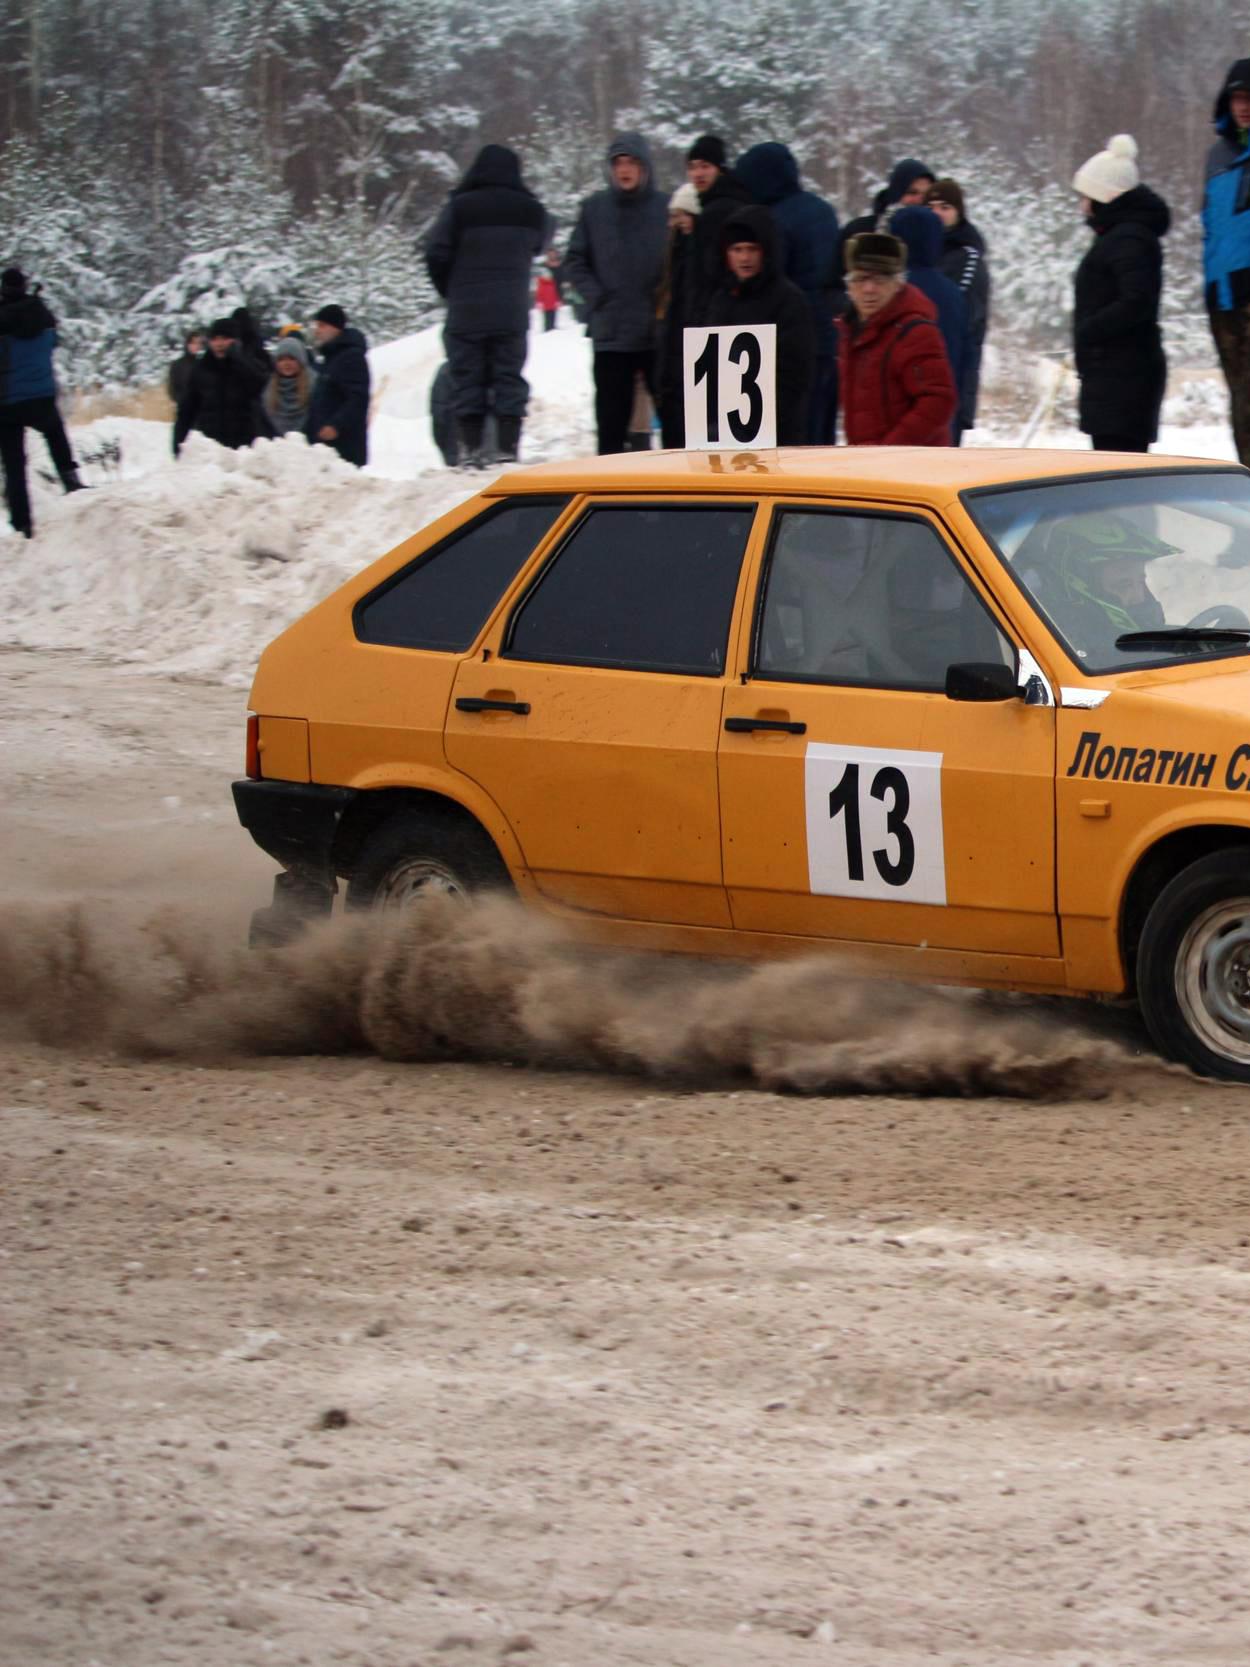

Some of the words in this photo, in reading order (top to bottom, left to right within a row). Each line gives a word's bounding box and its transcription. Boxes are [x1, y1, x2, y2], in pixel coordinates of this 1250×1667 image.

[694, 331, 763, 443] 13
[1066, 731, 1217, 788] Лопатин
[829, 763, 915, 886] 13
